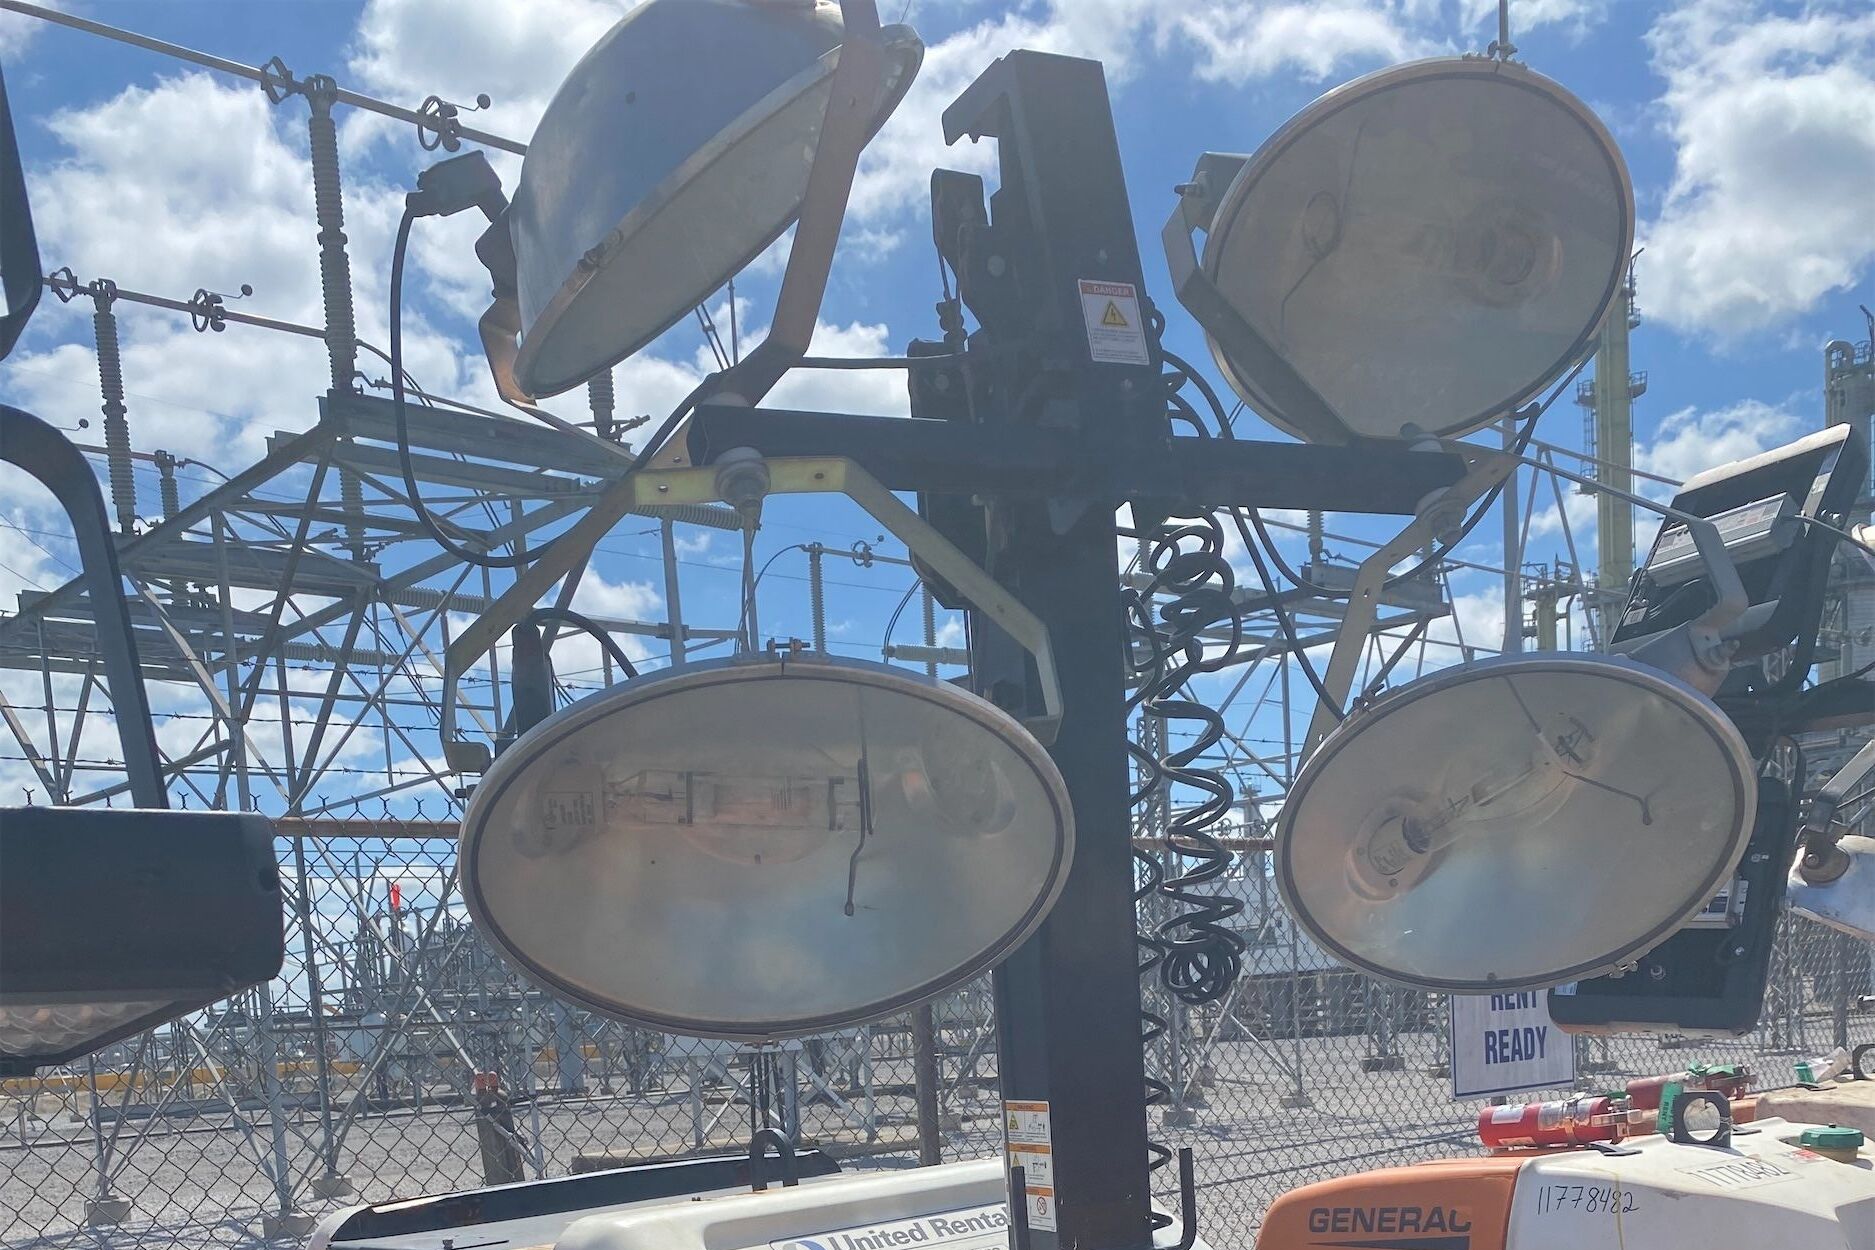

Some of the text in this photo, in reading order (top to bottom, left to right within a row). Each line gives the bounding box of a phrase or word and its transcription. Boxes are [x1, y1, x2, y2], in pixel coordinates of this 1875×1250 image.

[1093, 285, 1132, 297] DANGER
[1485, 1026, 1548, 1065] READY
[1536, 1185, 1641, 1216] 11778482
